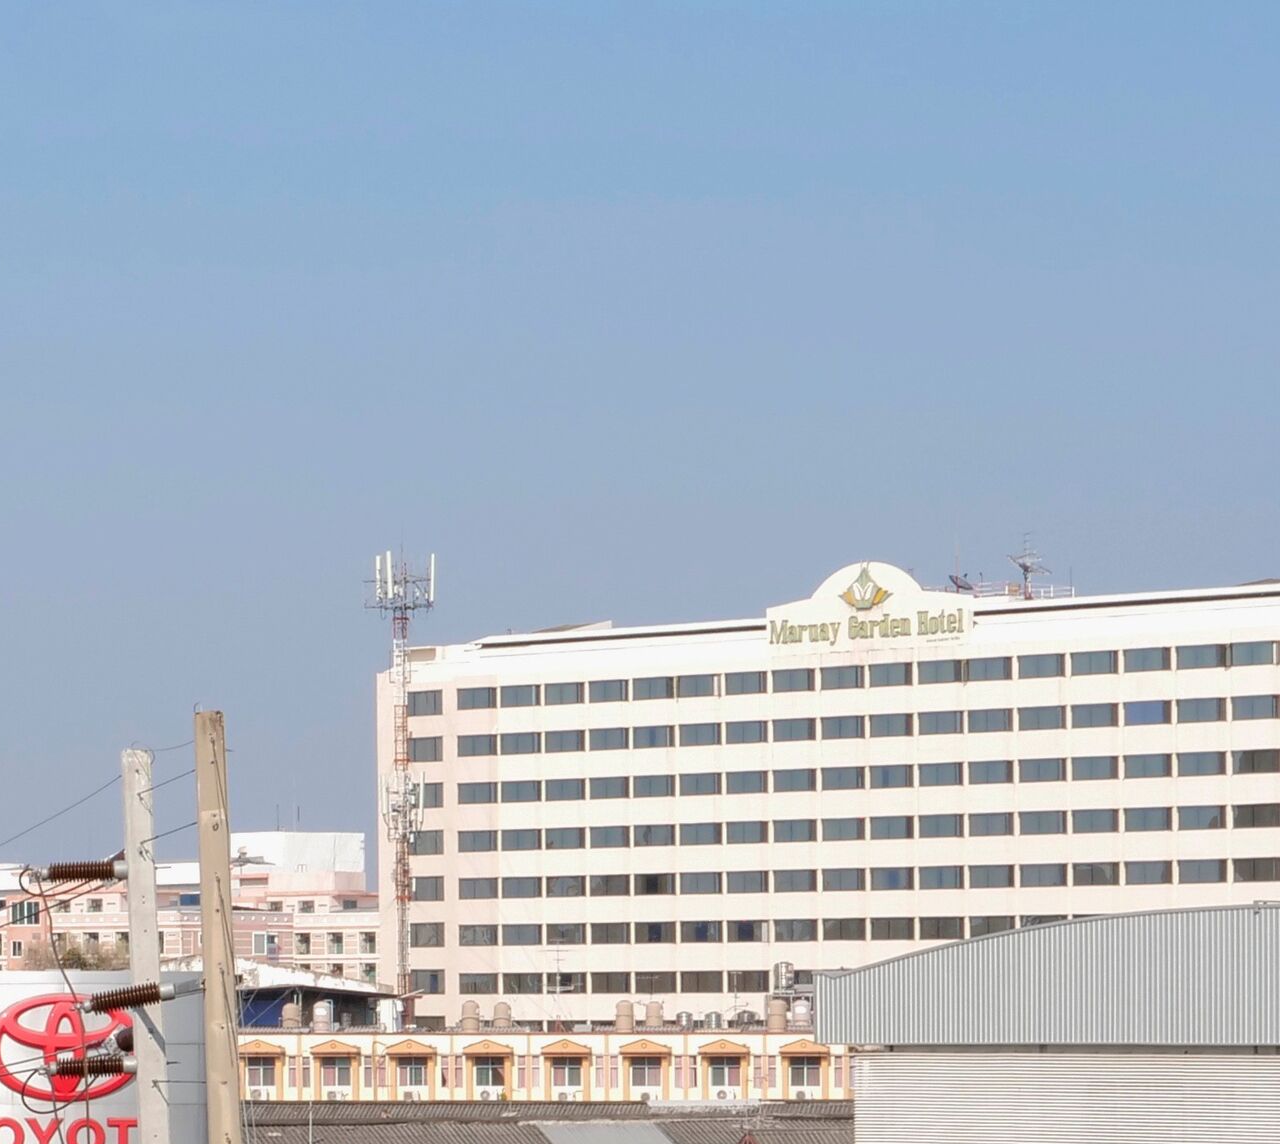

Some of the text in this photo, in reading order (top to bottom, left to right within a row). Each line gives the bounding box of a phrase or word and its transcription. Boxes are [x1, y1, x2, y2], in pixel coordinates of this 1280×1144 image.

[769, 608, 964, 646] Maruay Garden Hotel
